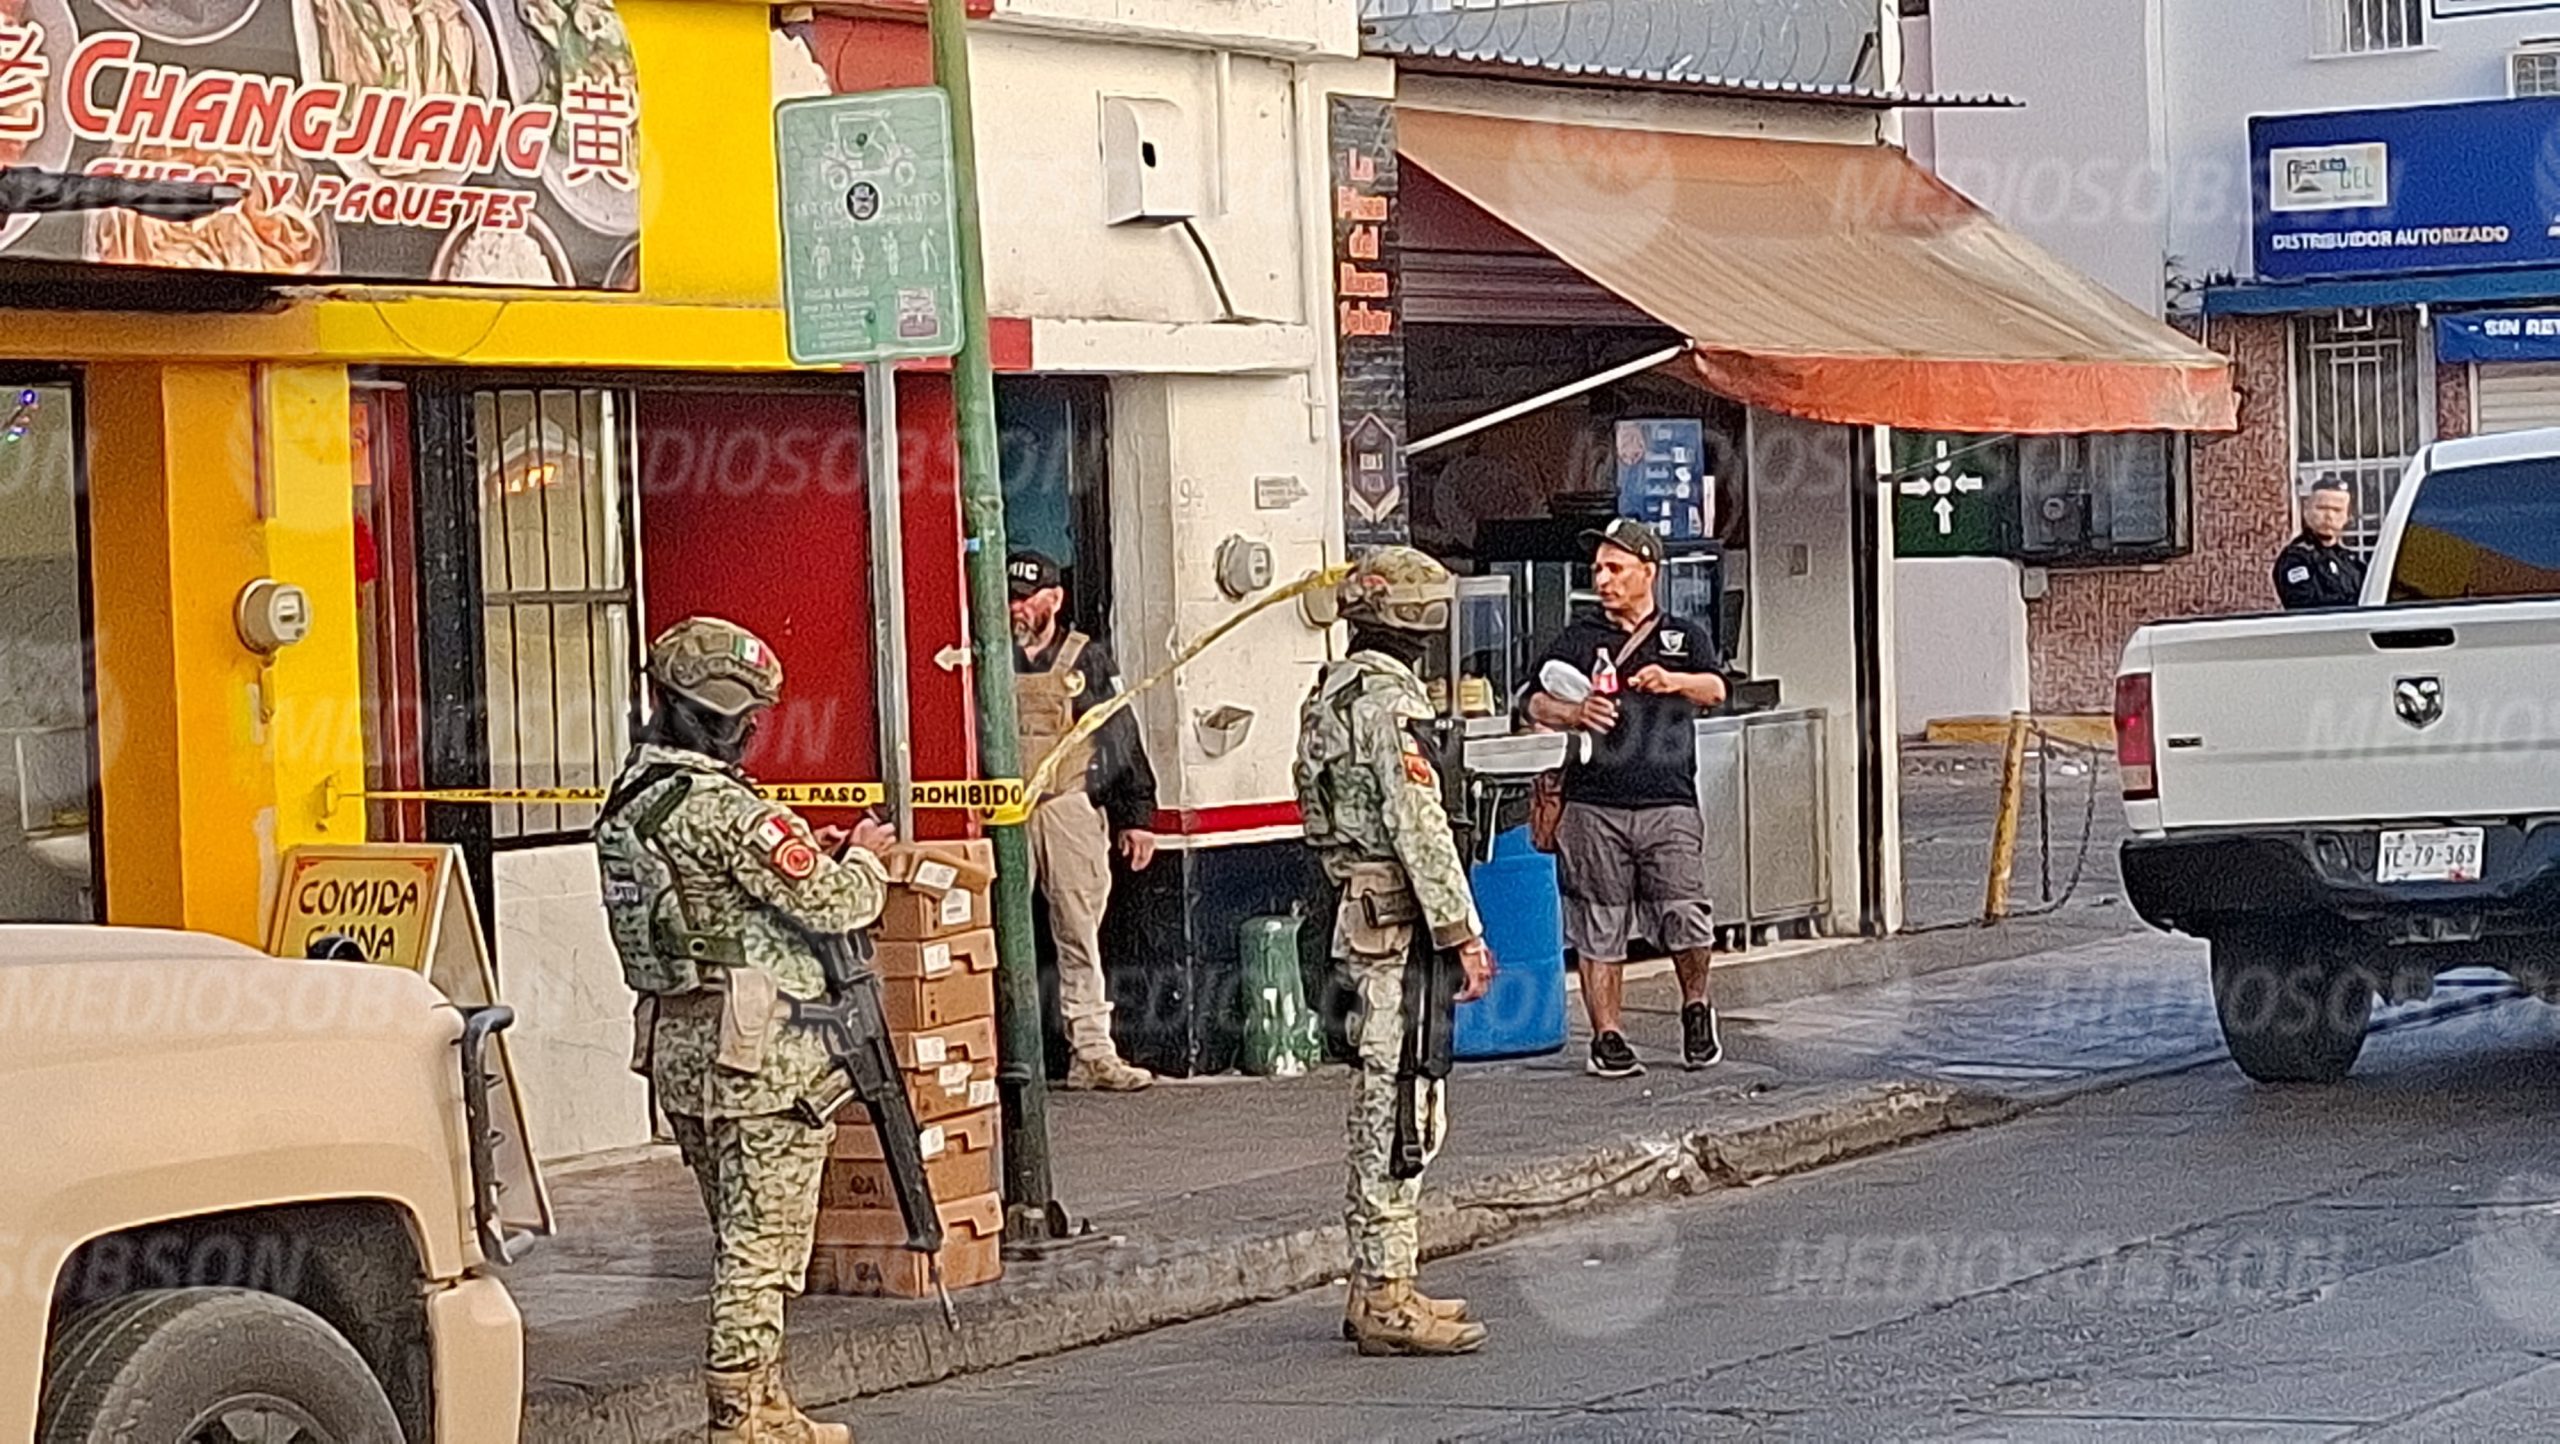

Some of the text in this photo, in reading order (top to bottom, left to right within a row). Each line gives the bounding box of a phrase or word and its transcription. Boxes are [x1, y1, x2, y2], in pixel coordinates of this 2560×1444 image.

[266, 175, 295, 208] Y
[319, 182, 532, 228] PAQUETES
[2272, 226, 2510, 250] DISTRIBUIDOR AUTORIZADO
[775, 787, 796, 802] EL
[808, 787, 868, 803] PASO
[911, 785, 1022, 807] ROHIBIDO
[300, 879, 419, 916] COMIDA
